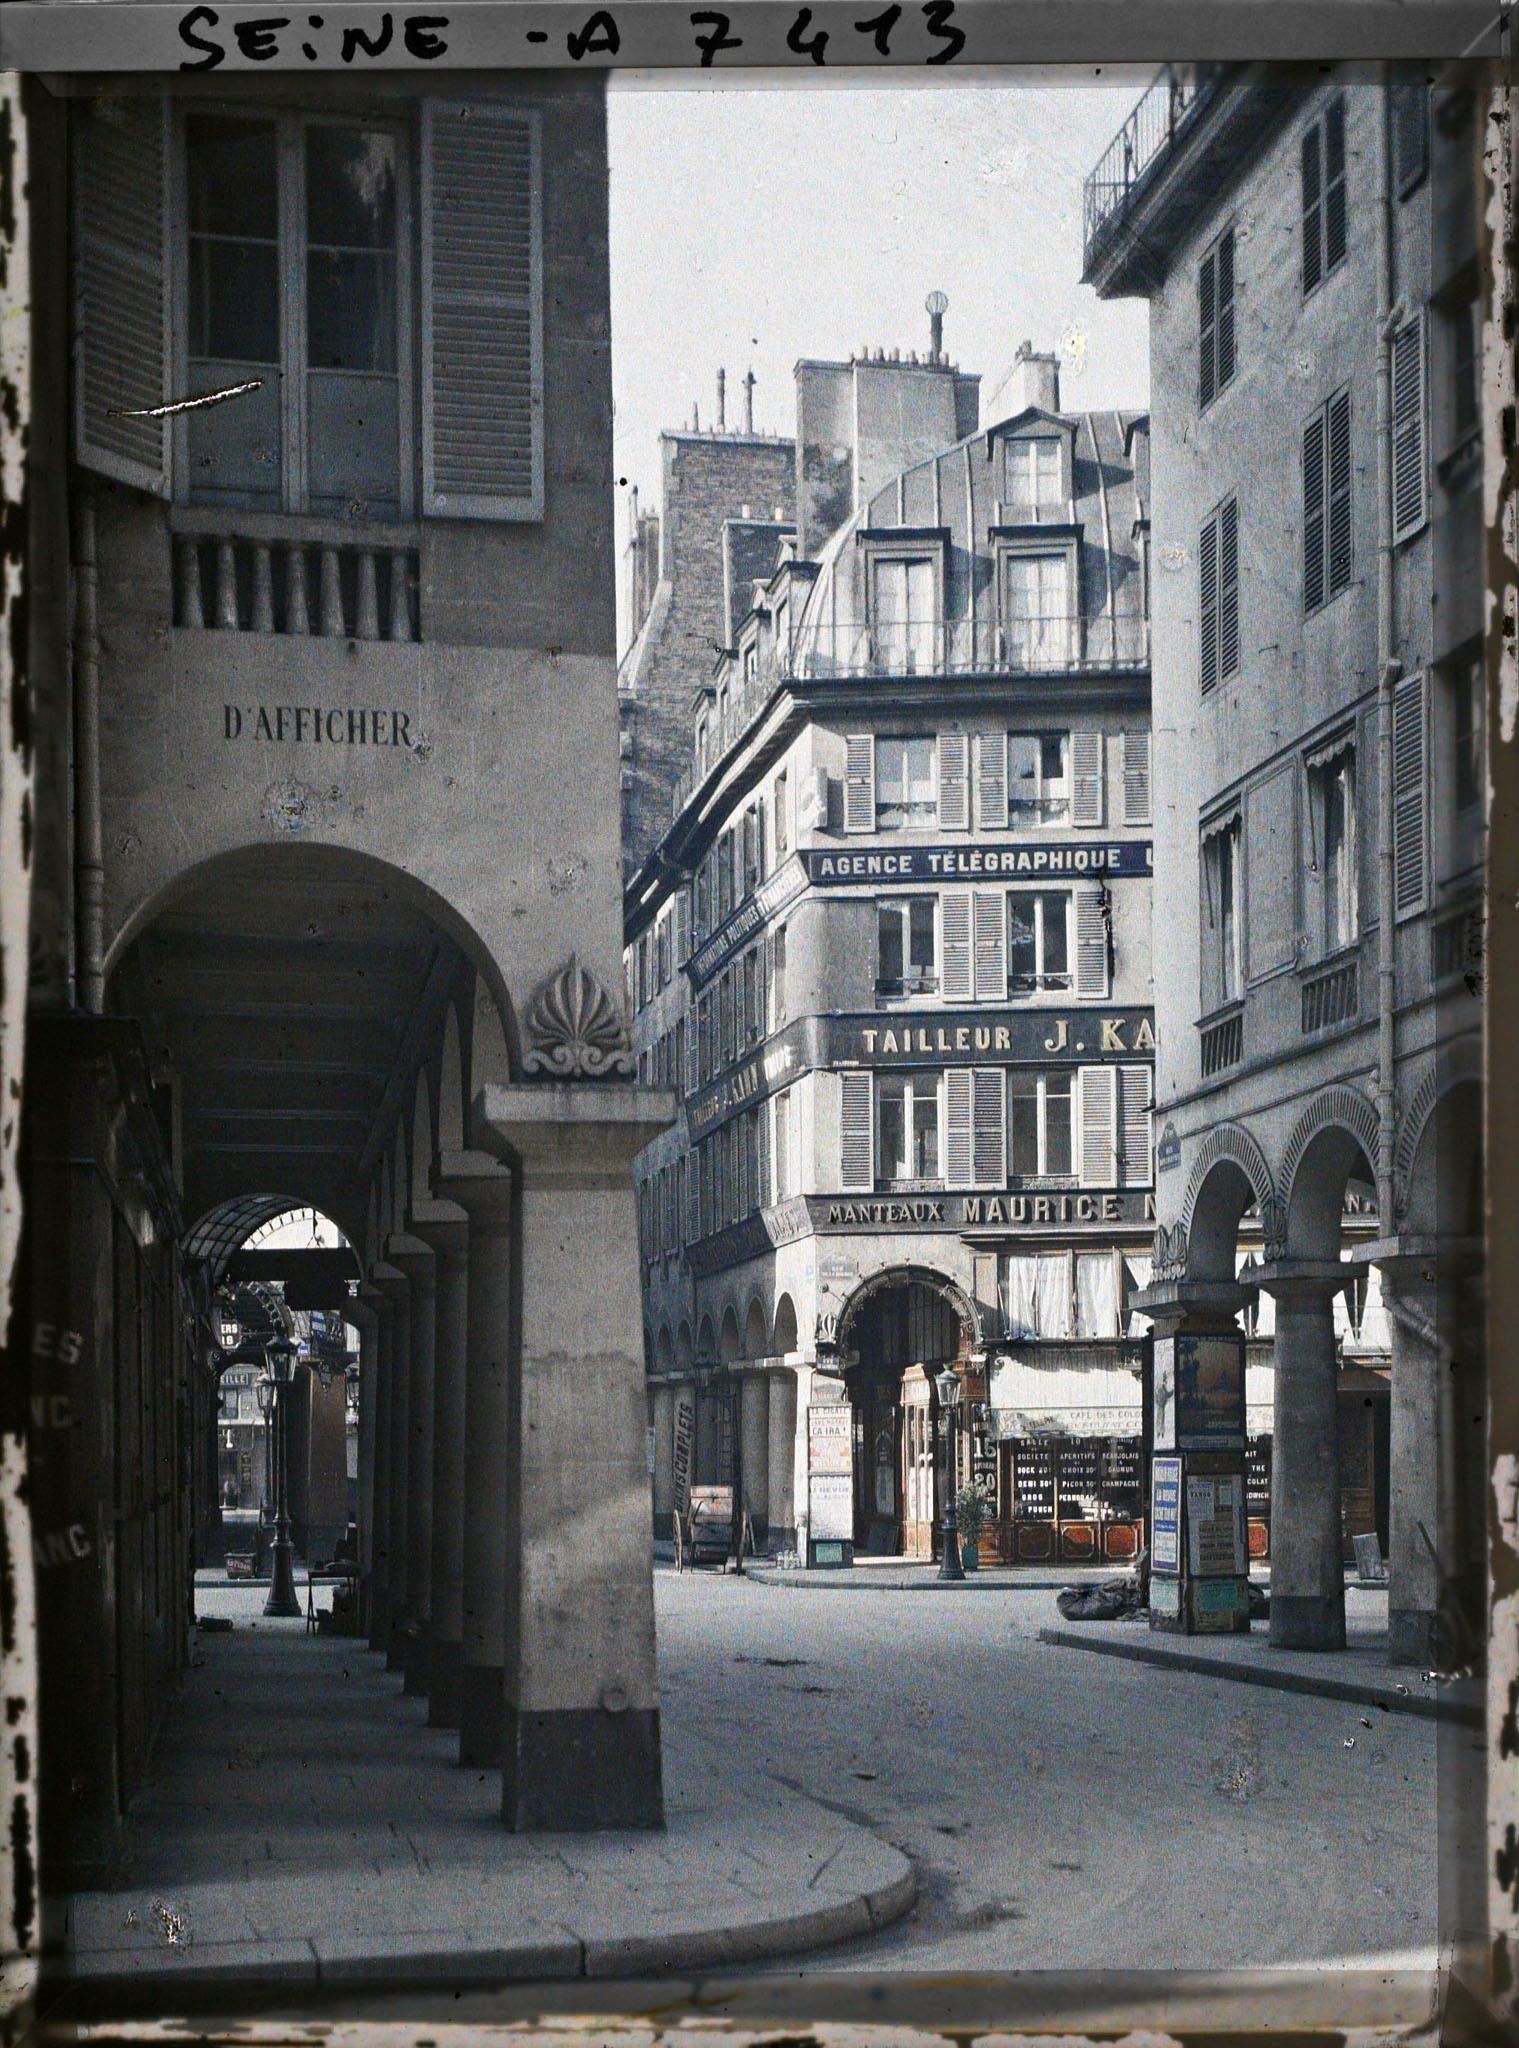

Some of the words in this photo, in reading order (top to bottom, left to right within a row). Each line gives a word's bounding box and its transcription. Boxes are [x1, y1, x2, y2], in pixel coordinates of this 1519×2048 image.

[223, 704, 414, 747] D'AFFICHER
[820, 854, 913, 876] AGENCE
[862, 1025, 1012, 1054] TAILLEUR
[1044, 1019, 1086, 1052] J.
[828, 1203, 945, 1224] MANTEAUX
[961, 1192, 1121, 1221] MAURICE
[676, 1403, 694, 1475] COMPLETS
[1017, 1466, 1035, 1474] BOCK
[1101, 1480, 1140, 1488] CHAMPAGNE
[1027, 1505, 1053, 1514] PUNCH
